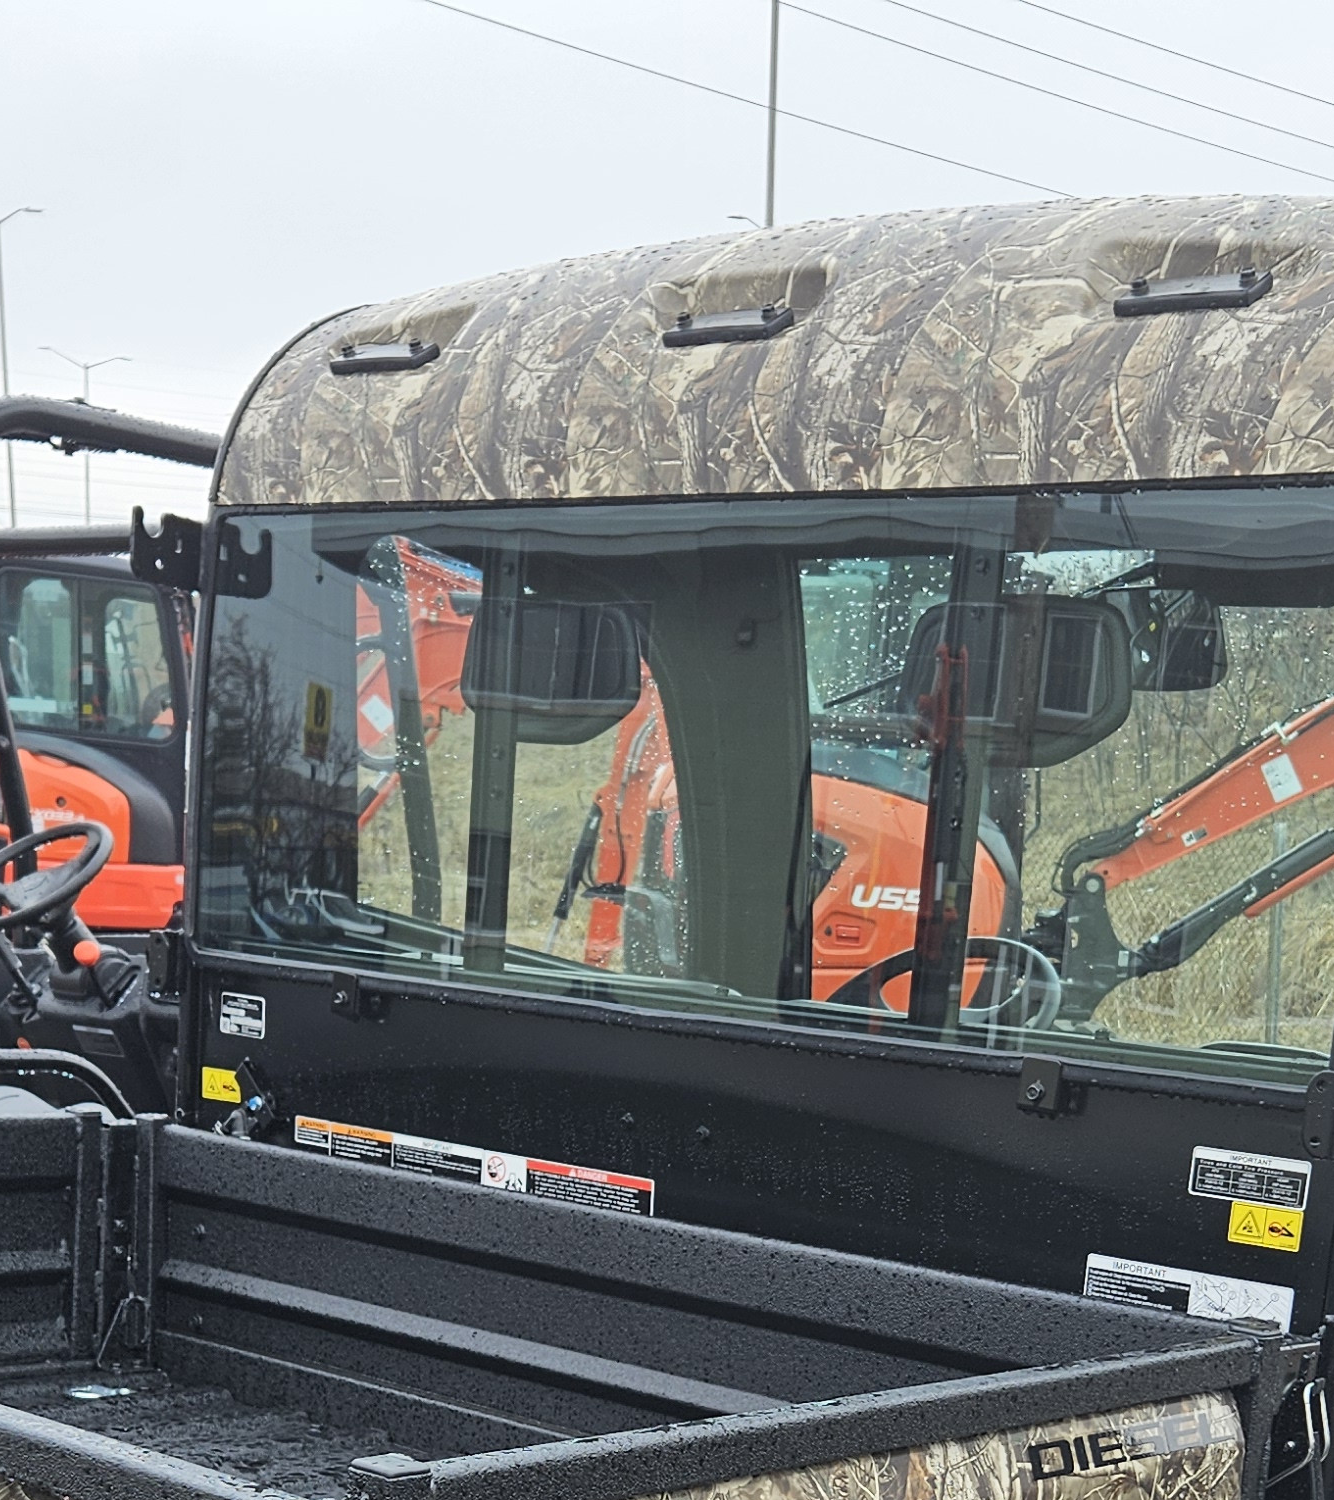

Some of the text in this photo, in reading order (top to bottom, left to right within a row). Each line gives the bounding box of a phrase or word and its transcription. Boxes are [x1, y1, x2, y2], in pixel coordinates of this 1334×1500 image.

[1230, 1155, 1272, 1167] IMPORTANT
[577, 1169, 608, 1182] DANGER
[1112, 1261, 1167, 1278] IMPORTANT
[1028, 1410, 1237, 1481] DIESEL
